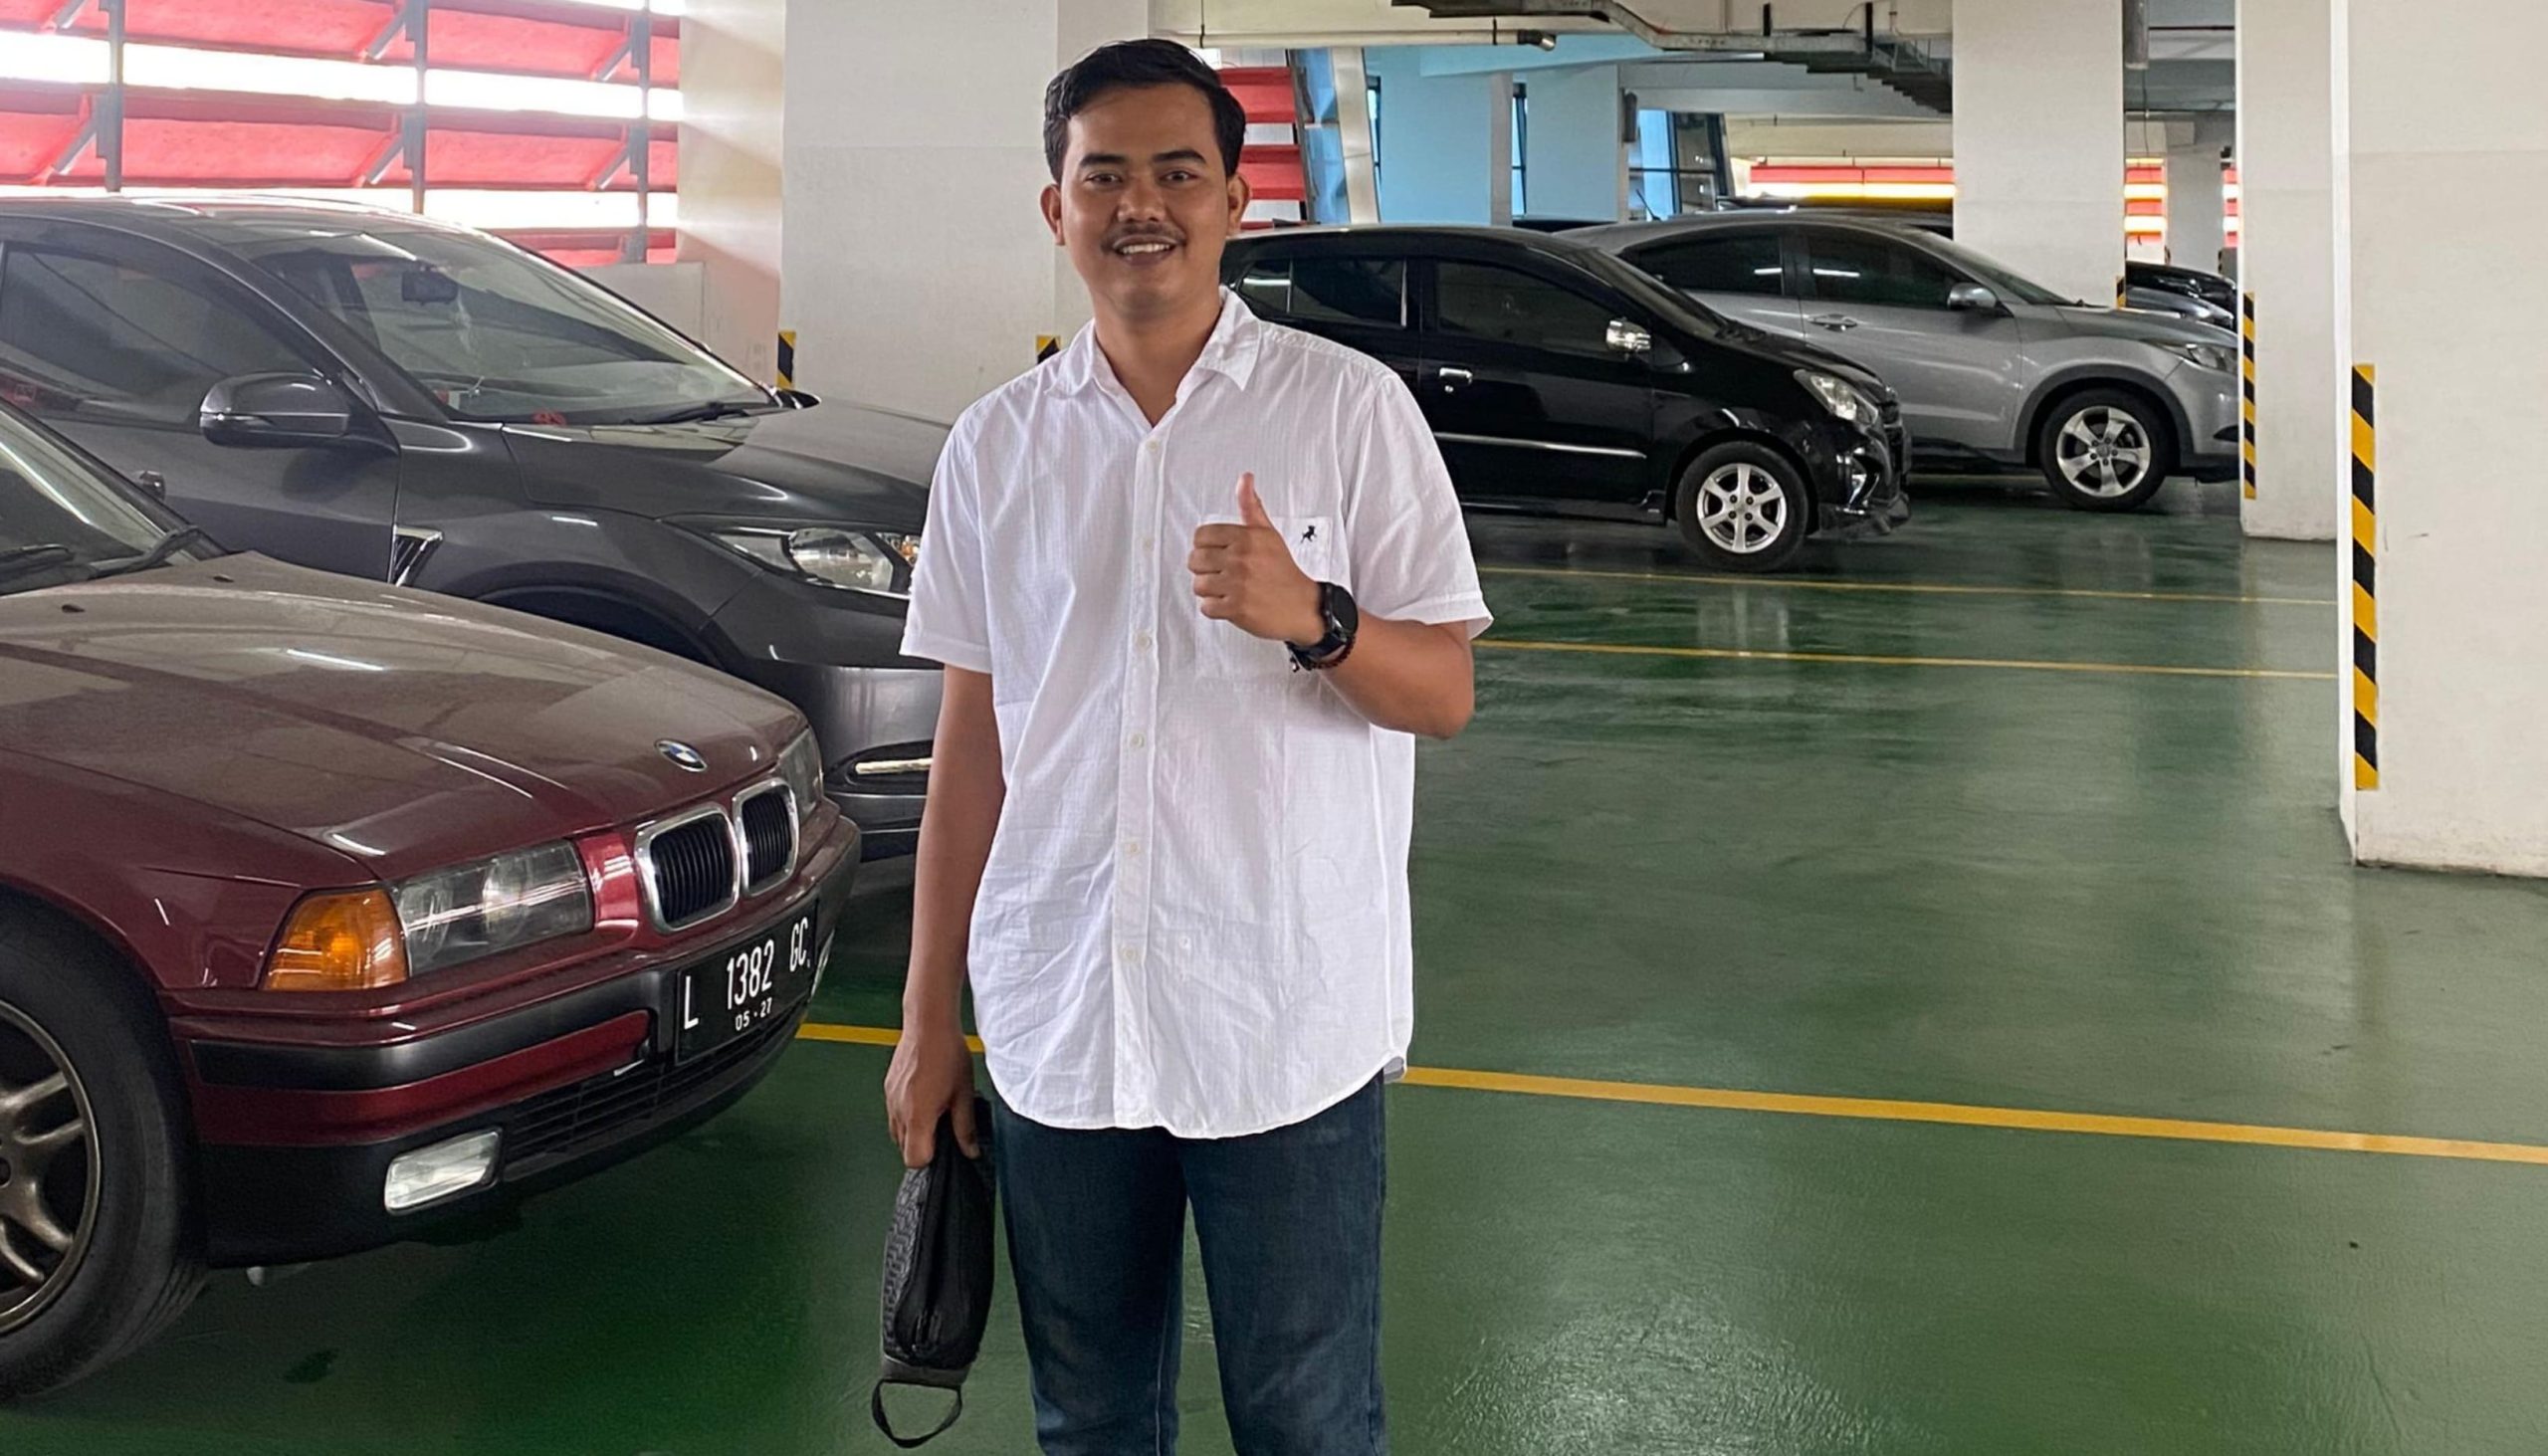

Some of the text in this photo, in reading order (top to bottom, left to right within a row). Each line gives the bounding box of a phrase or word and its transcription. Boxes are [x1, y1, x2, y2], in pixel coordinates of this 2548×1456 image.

[684, 917, 808, 1030] L 1382 GC
